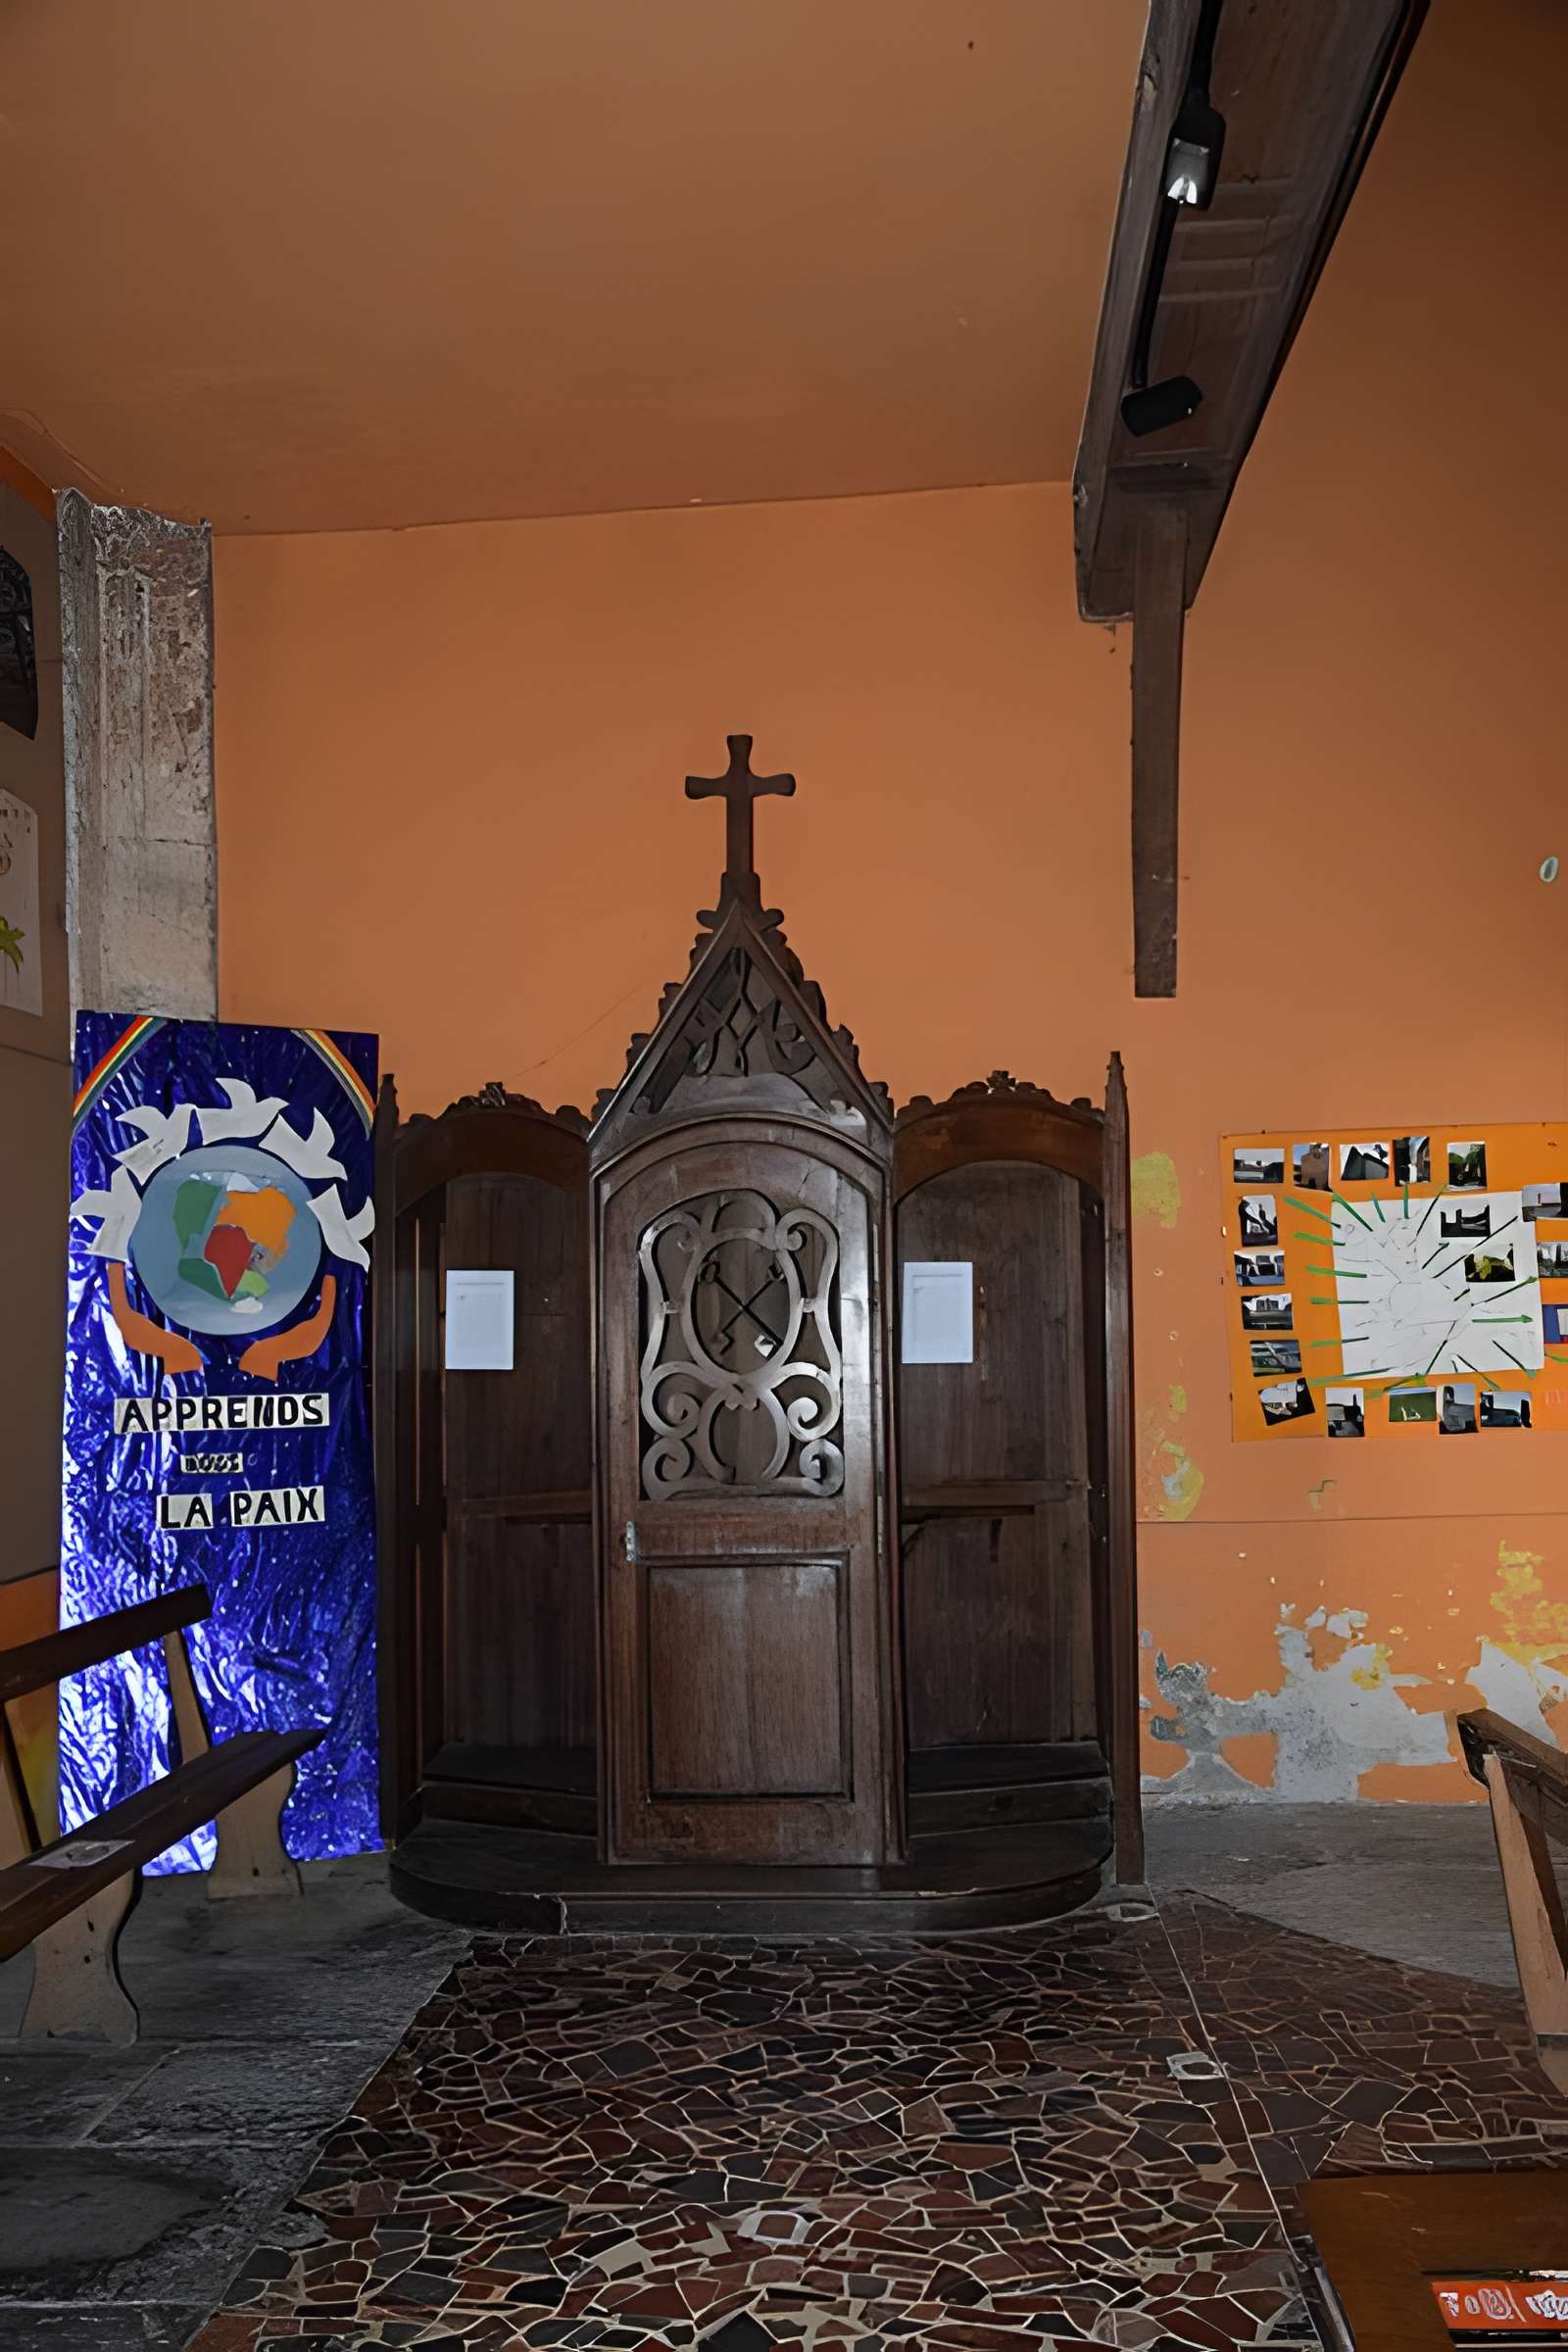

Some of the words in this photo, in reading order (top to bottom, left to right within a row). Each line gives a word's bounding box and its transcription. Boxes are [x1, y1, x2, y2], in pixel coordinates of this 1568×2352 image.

[121, 1395, 323, 1433] APPRENDS
[161, 1495, 212, 1529] LA
[234, 1488, 318, 1525] PAIX
